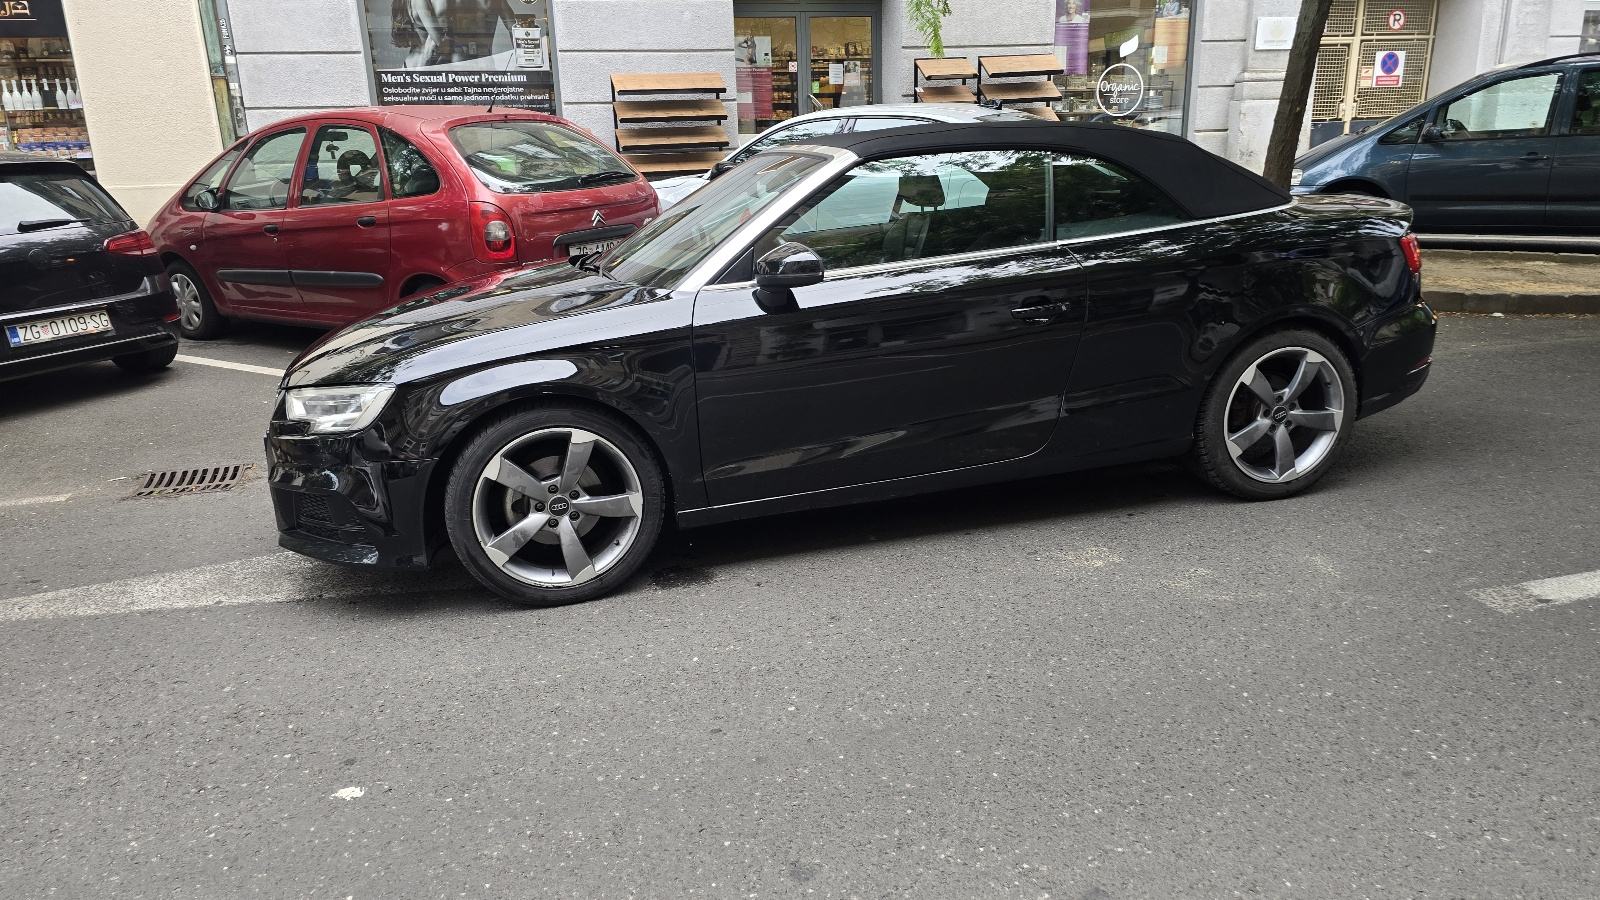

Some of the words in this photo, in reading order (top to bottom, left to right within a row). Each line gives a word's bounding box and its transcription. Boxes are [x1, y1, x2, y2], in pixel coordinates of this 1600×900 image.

[381, 73, 411, 83] Men's
[412, 72, 447, 83] Sexual
[448, 73, 480, 82] Power
[481, 72, 527, 82] Premium
[382, 86, 421, 94] Oslobodite
[421, 86, 440, 94] zvijer
[463, 86, 482, 94] Tajna
[483, 86, 525, 94] nevjerojatne
[1101, 81, 1140, 98] Organic
[19, 324, 41, 341] ZG
[49, 313, 109, 336] 0109-SG
